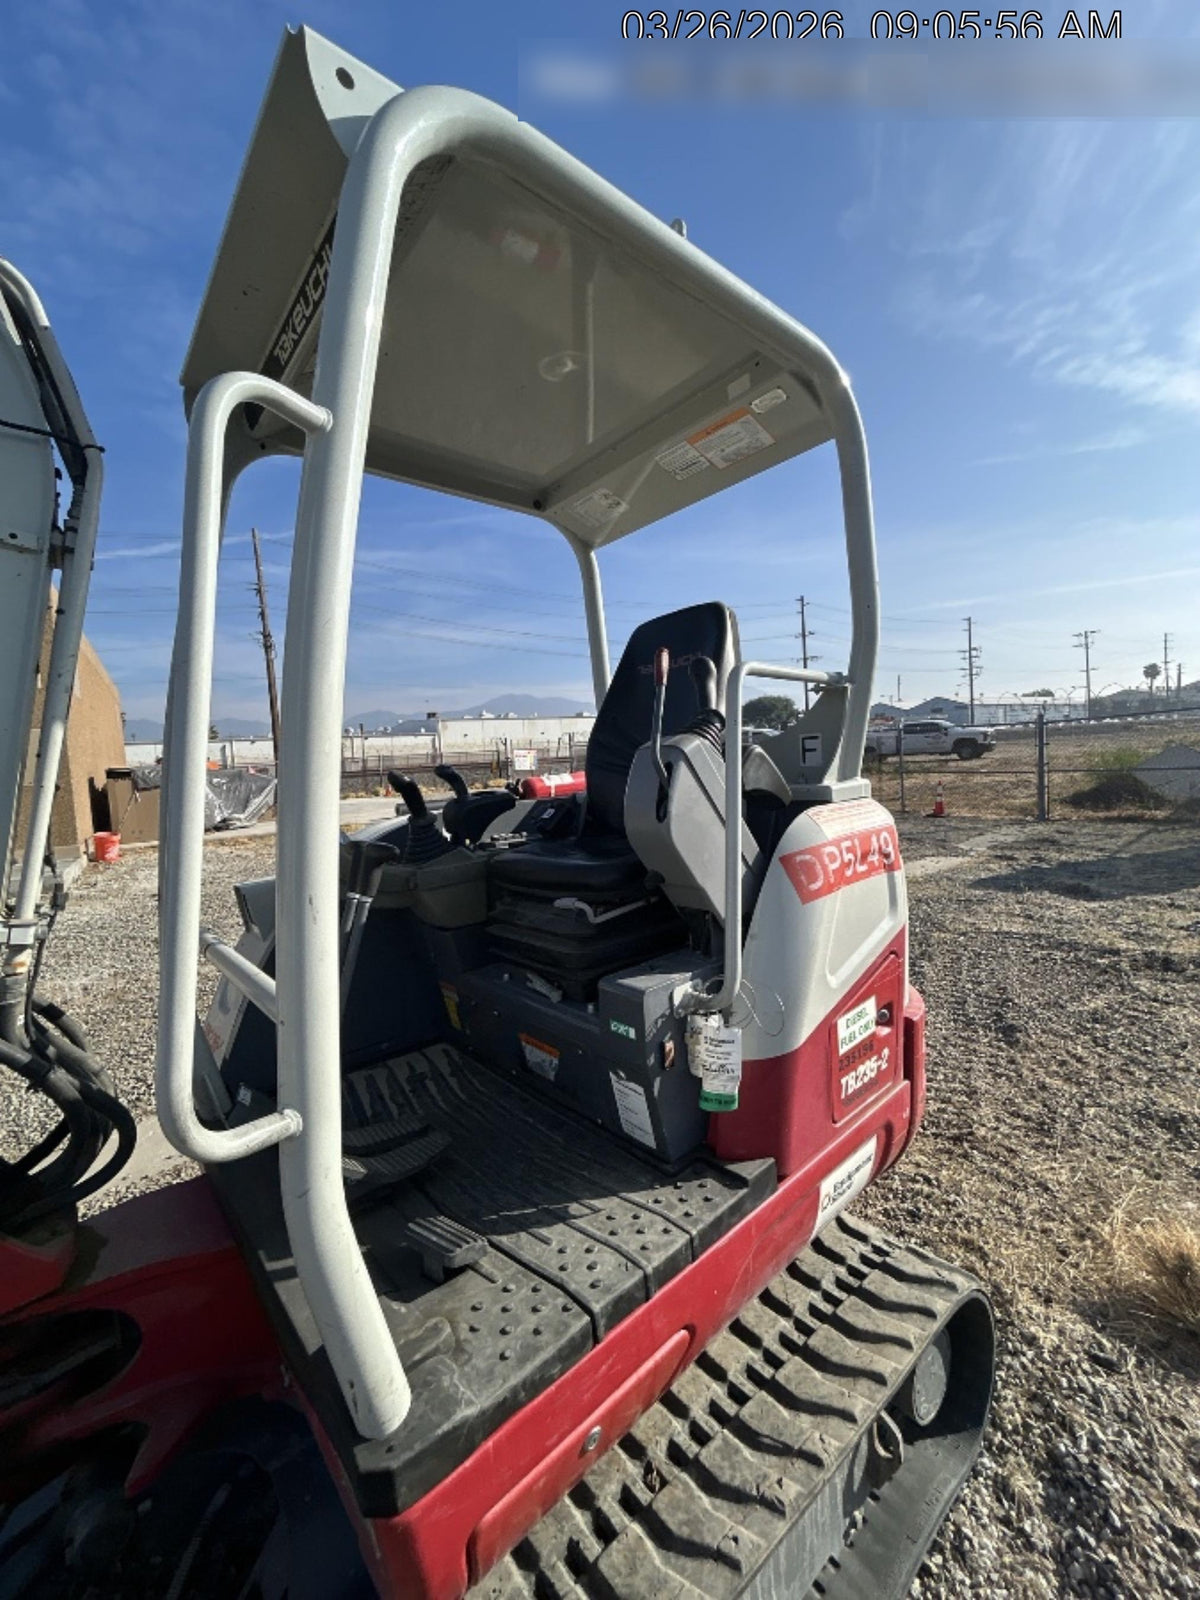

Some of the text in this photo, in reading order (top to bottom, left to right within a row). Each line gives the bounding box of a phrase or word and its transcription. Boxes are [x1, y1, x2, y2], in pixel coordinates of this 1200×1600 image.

[801, 735, 820, 764] F
[794, 831, 896, 891] DP5L49
[840, 1030, 857, 1050] FUEL
[840, 1047, 890, 1100] TB235-2
